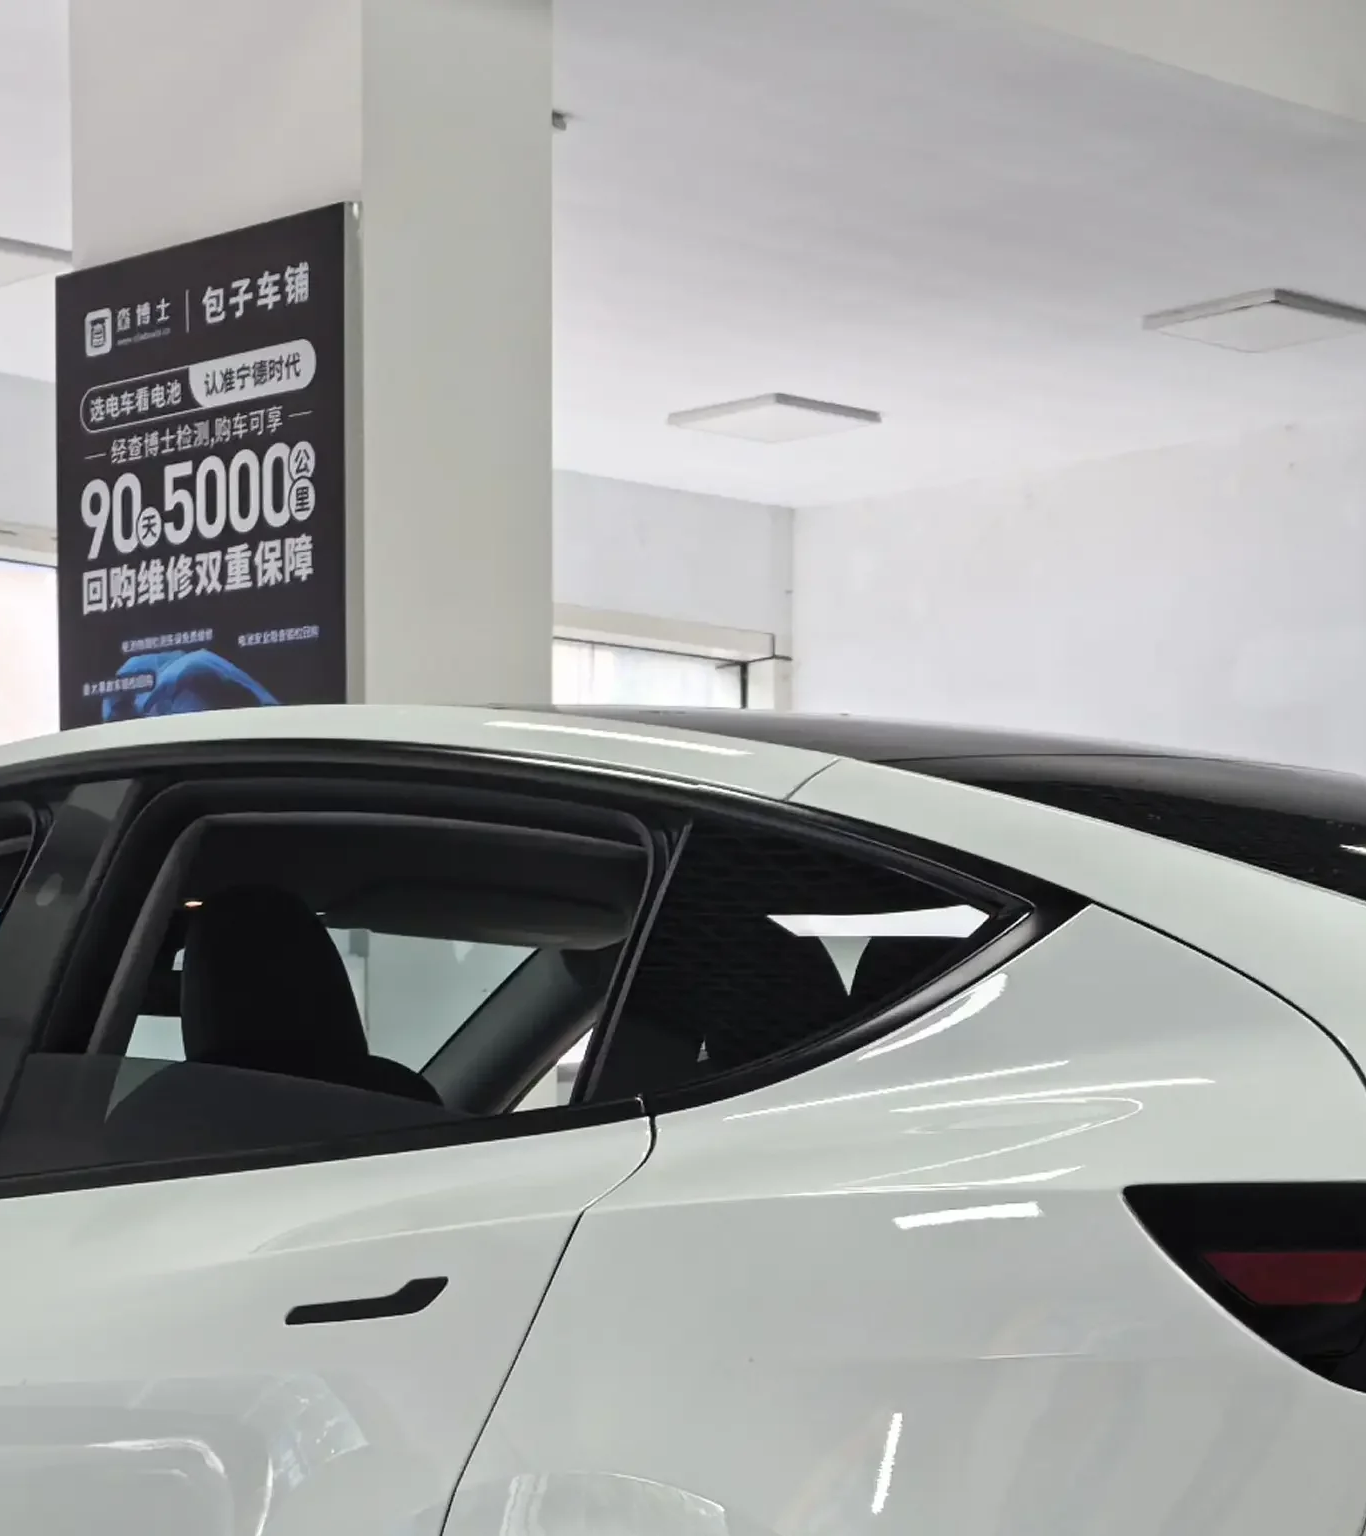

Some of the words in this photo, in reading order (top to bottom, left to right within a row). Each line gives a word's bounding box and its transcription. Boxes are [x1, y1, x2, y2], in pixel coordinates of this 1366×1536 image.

[202, 262, 310, 324] 包子车铺
[90, 379, 183, 423] 选电车看电池
[204, 352, 301, 397] 认准宁德时代
[83, 533, 314, 616] 回购维修双重保障
